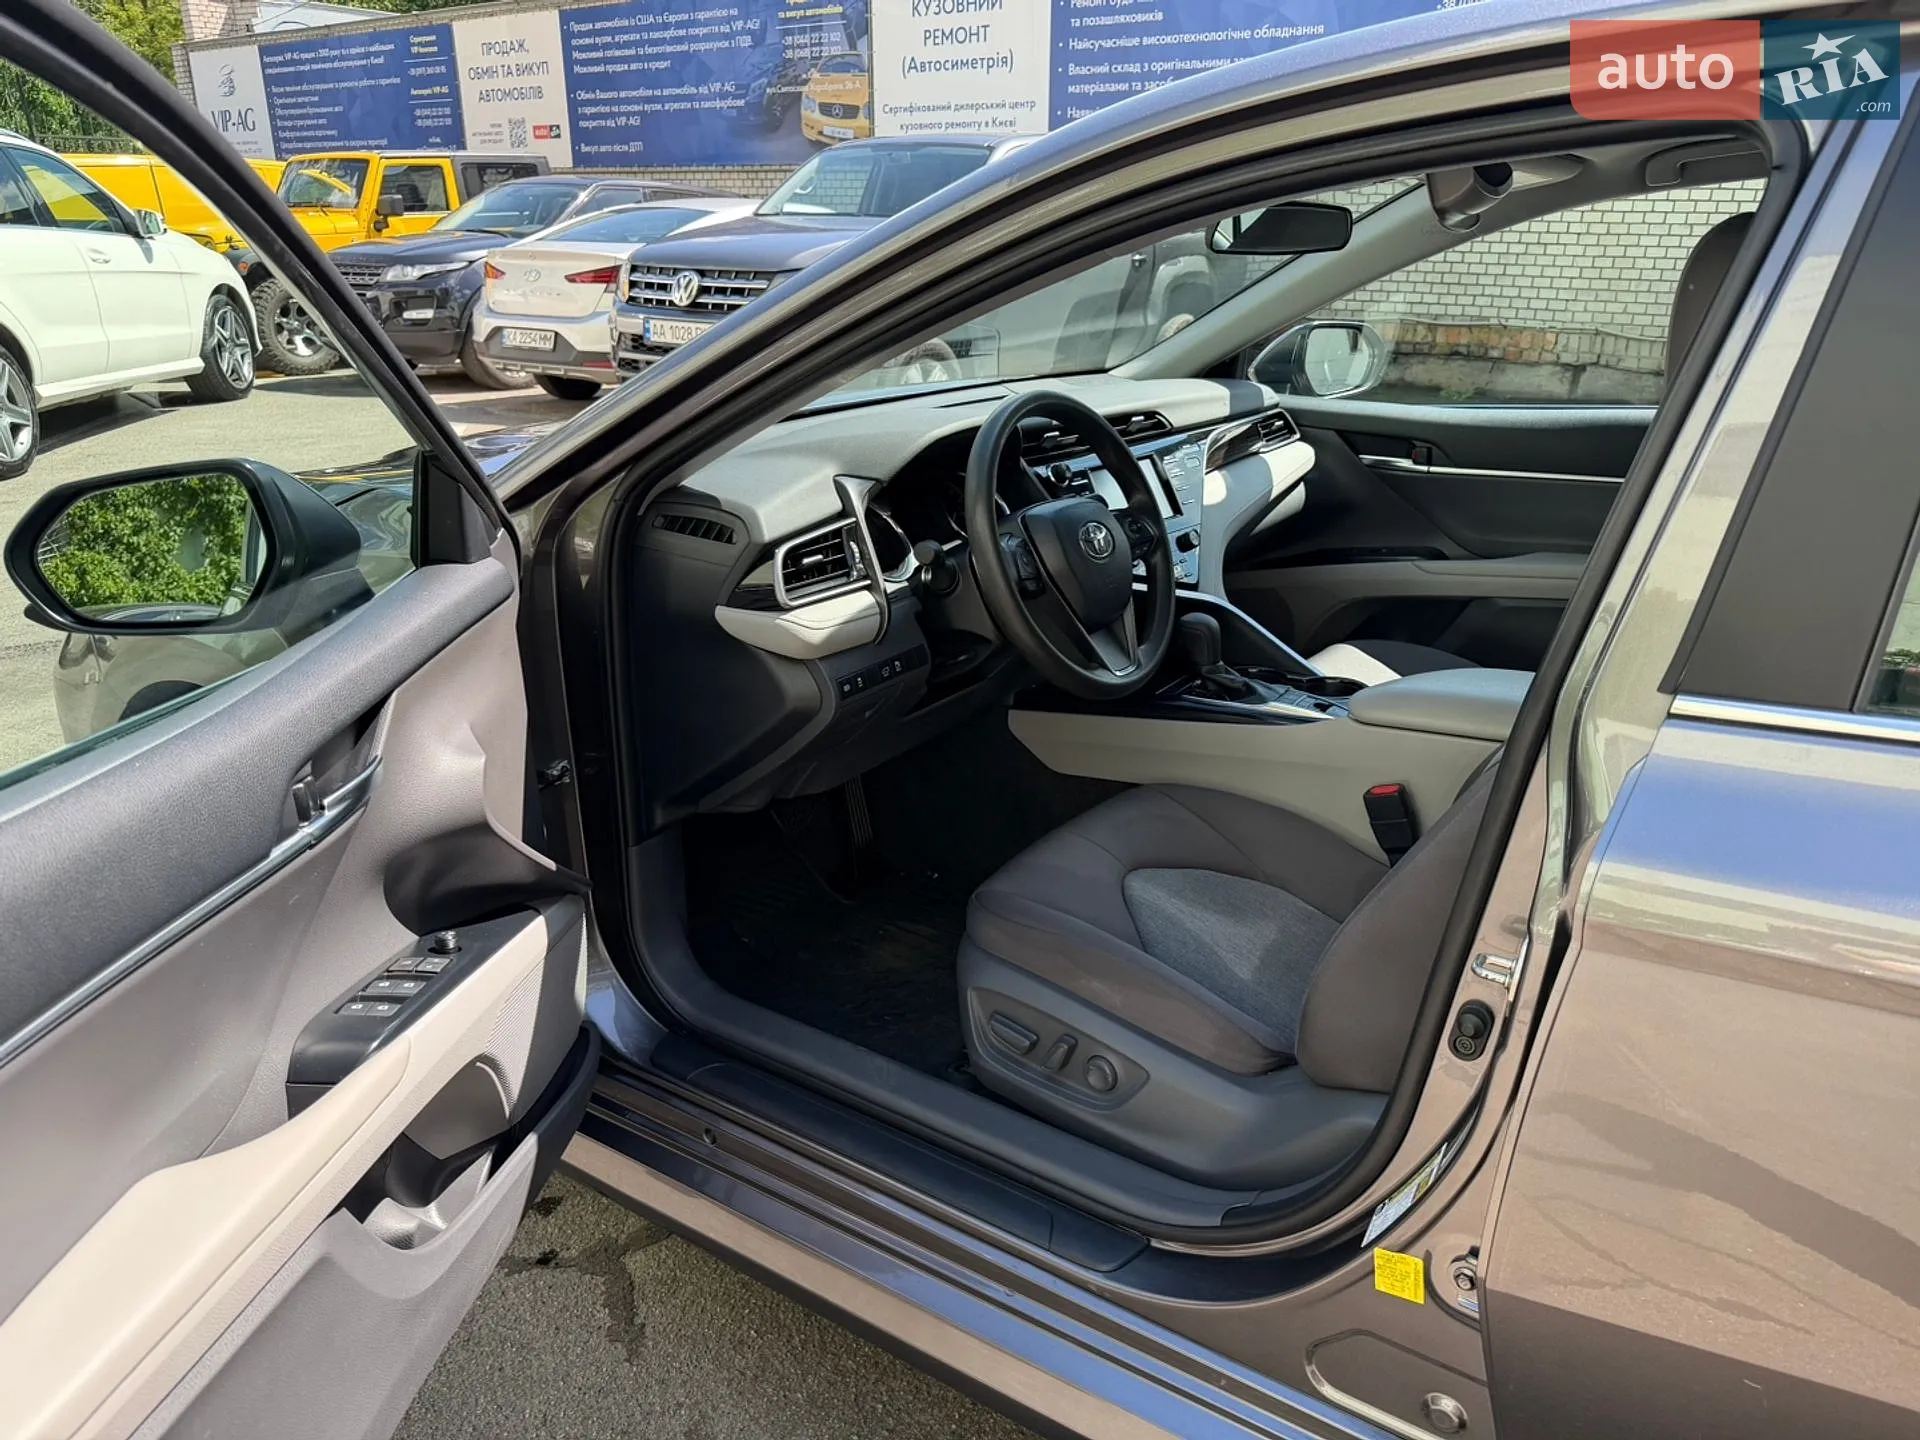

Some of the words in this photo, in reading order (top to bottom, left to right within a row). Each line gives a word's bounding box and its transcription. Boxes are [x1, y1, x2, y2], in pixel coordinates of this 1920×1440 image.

[636, 13, 655, 25] США
[730, 8, 738, 16] на
[1071, 18, 1080, 27] та
[1083, 10, 1163, 26] позашляховиків
[923, 24, 990, 47] РЕМОНТ
[1069, 36, 1140, 51] Найсучасніше
[1143, 28, 1251, 45] високотехнологічне
[1254, 24, 1324, 38] обладнання
[481, 39, 530, 57] ПРОДАЖ,
[468, 65, 499, 80] ОБМІН
[500, 64, 514, 78] ТА
[515, 61, 550, 77] ВИКУП
[902, 49, 1014, 79] (Автосиметрія)
[1068, 62, 1109, 75] Власний
[1111, 62, 1141, 73] склад
[1143, 62, 1148, 71] з
[1151, 58, 1231, 75] оригінальними
[478, 86, 543, 103] АВТОМОБІЛІВ
[1068, 81, 1129, 95] матеріалами
[1132, 82, 1141, 91] та
[882, 102, 951, 116] Сертифікований
[954, 99, 1006, 113] дилерський
[1009, 98, 1036, 111] центр
[900, 121, 943, 135] кузовного
[945, 119, 982, 131] ремонту
[991, 116, 1017, 129] Києві
[653, 323, 667, 340] AA
[669, 325, 692, 341] 1028
